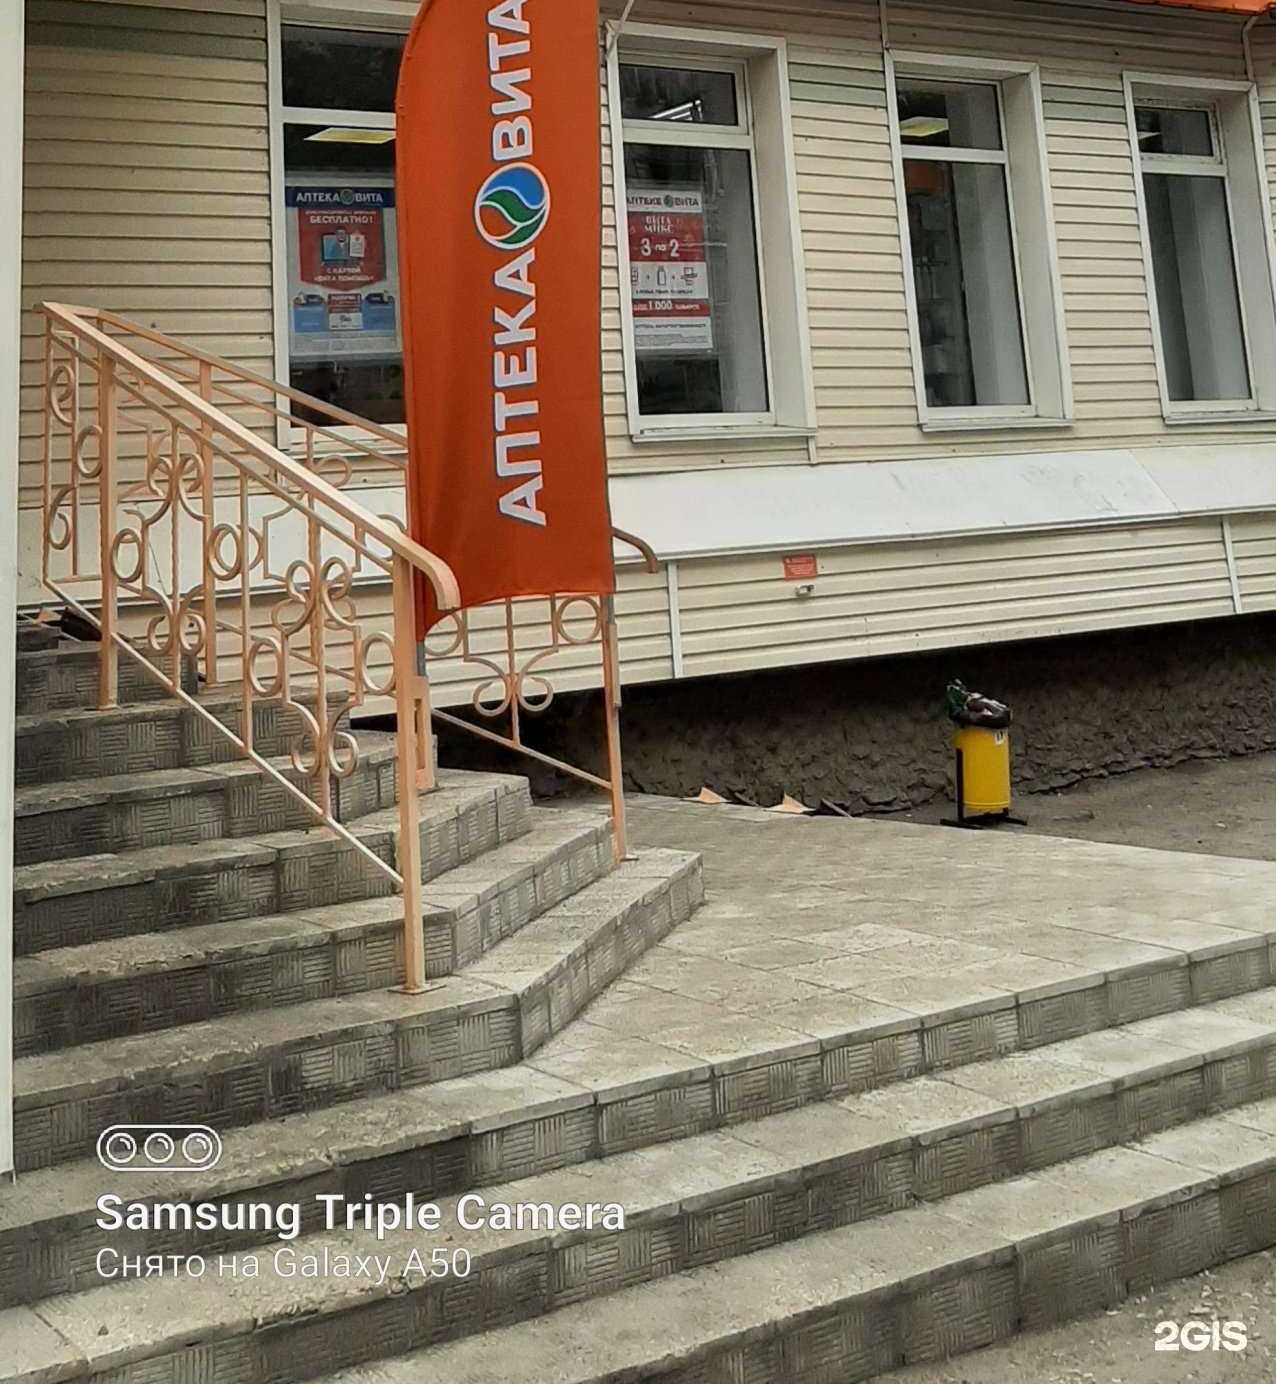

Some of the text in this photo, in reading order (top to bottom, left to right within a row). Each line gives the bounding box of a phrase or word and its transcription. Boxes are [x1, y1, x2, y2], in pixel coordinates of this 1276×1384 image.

[296, 192, 383, 203] АПТЕКА ВИТА
[309, 215, 374, 225] БЕСПЛАТНО!
[640, 237, 652, 257] 3
[669, 238, 681, 257] 2
[494, 246, 548, 527] АПТЕКА
